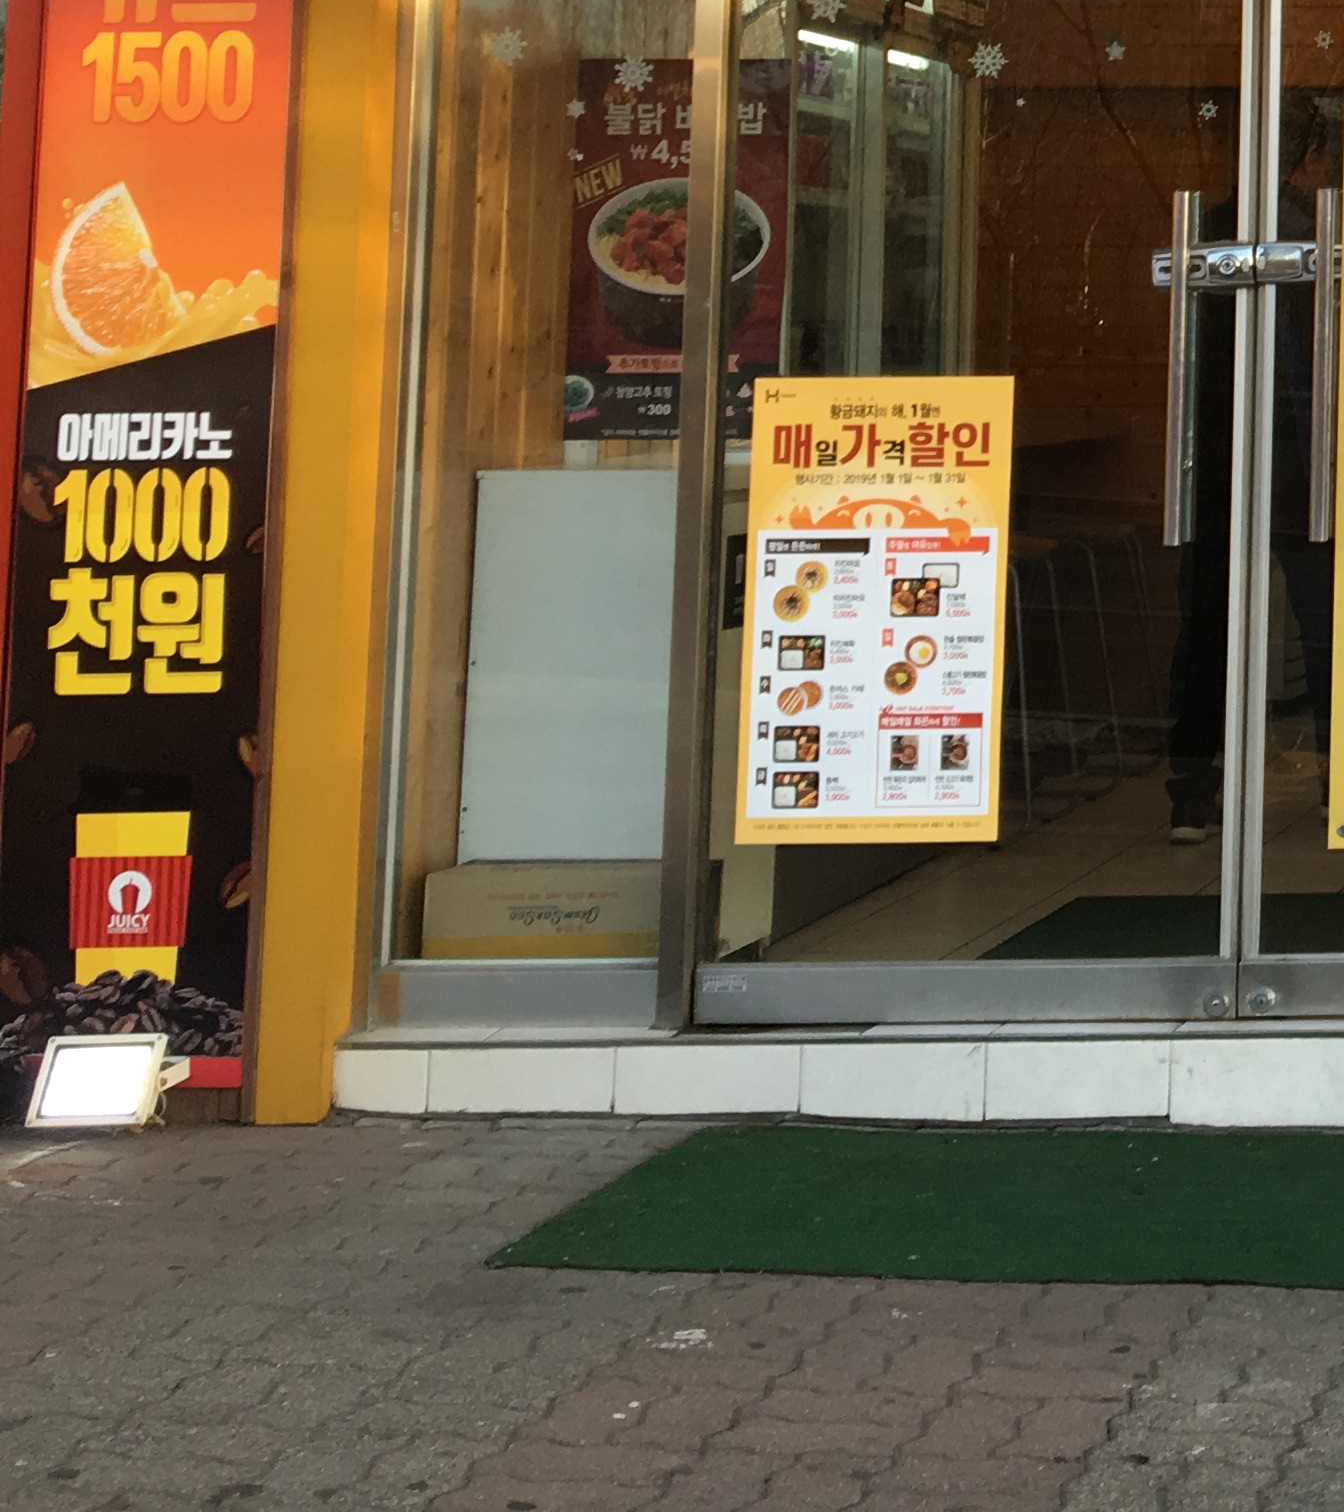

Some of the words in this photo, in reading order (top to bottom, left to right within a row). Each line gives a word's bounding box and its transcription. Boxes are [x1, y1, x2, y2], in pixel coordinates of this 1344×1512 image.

[82, 30, 254, 124] 1500
[604, 102, 666, 135] 불닭
[575, 160, 623, 203] NEW
[56, 412, 233, 462] 아메리카노
[53, 468, 231, 564] 1000
[47, 568, 225, 696] 천원
[108, 914, 150, 929] JUICY
